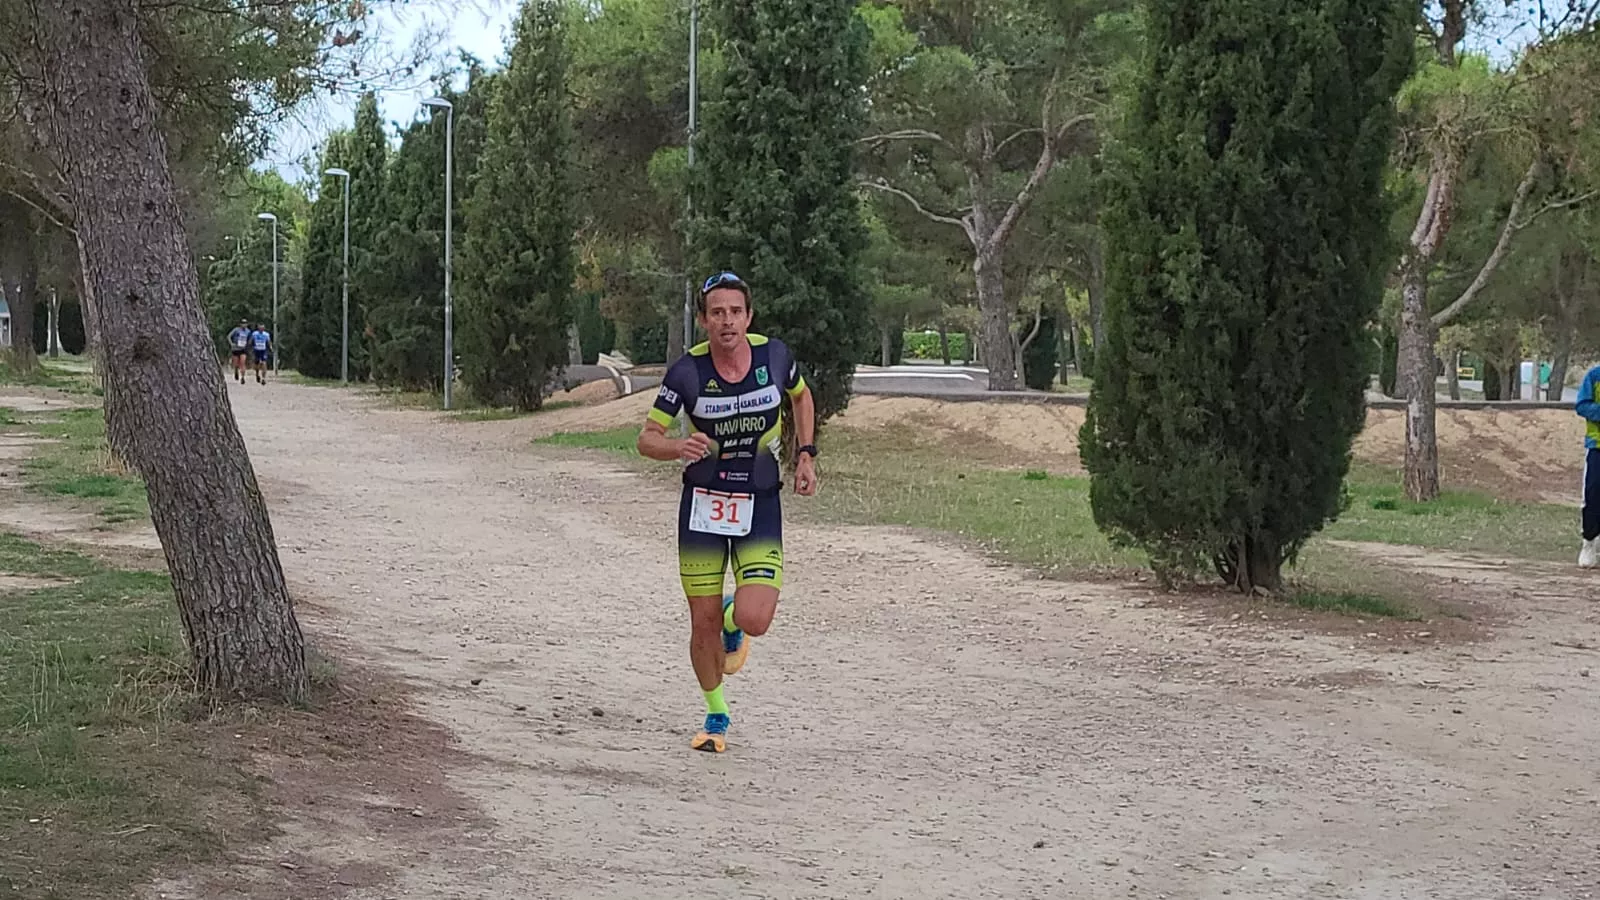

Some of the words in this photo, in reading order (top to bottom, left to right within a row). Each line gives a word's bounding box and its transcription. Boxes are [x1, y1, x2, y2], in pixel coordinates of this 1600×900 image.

[705, 403, 731, 414] STADIUM
[714, 416, 766, 436] NAVARRO
[709, 499, 740, 524] 31
